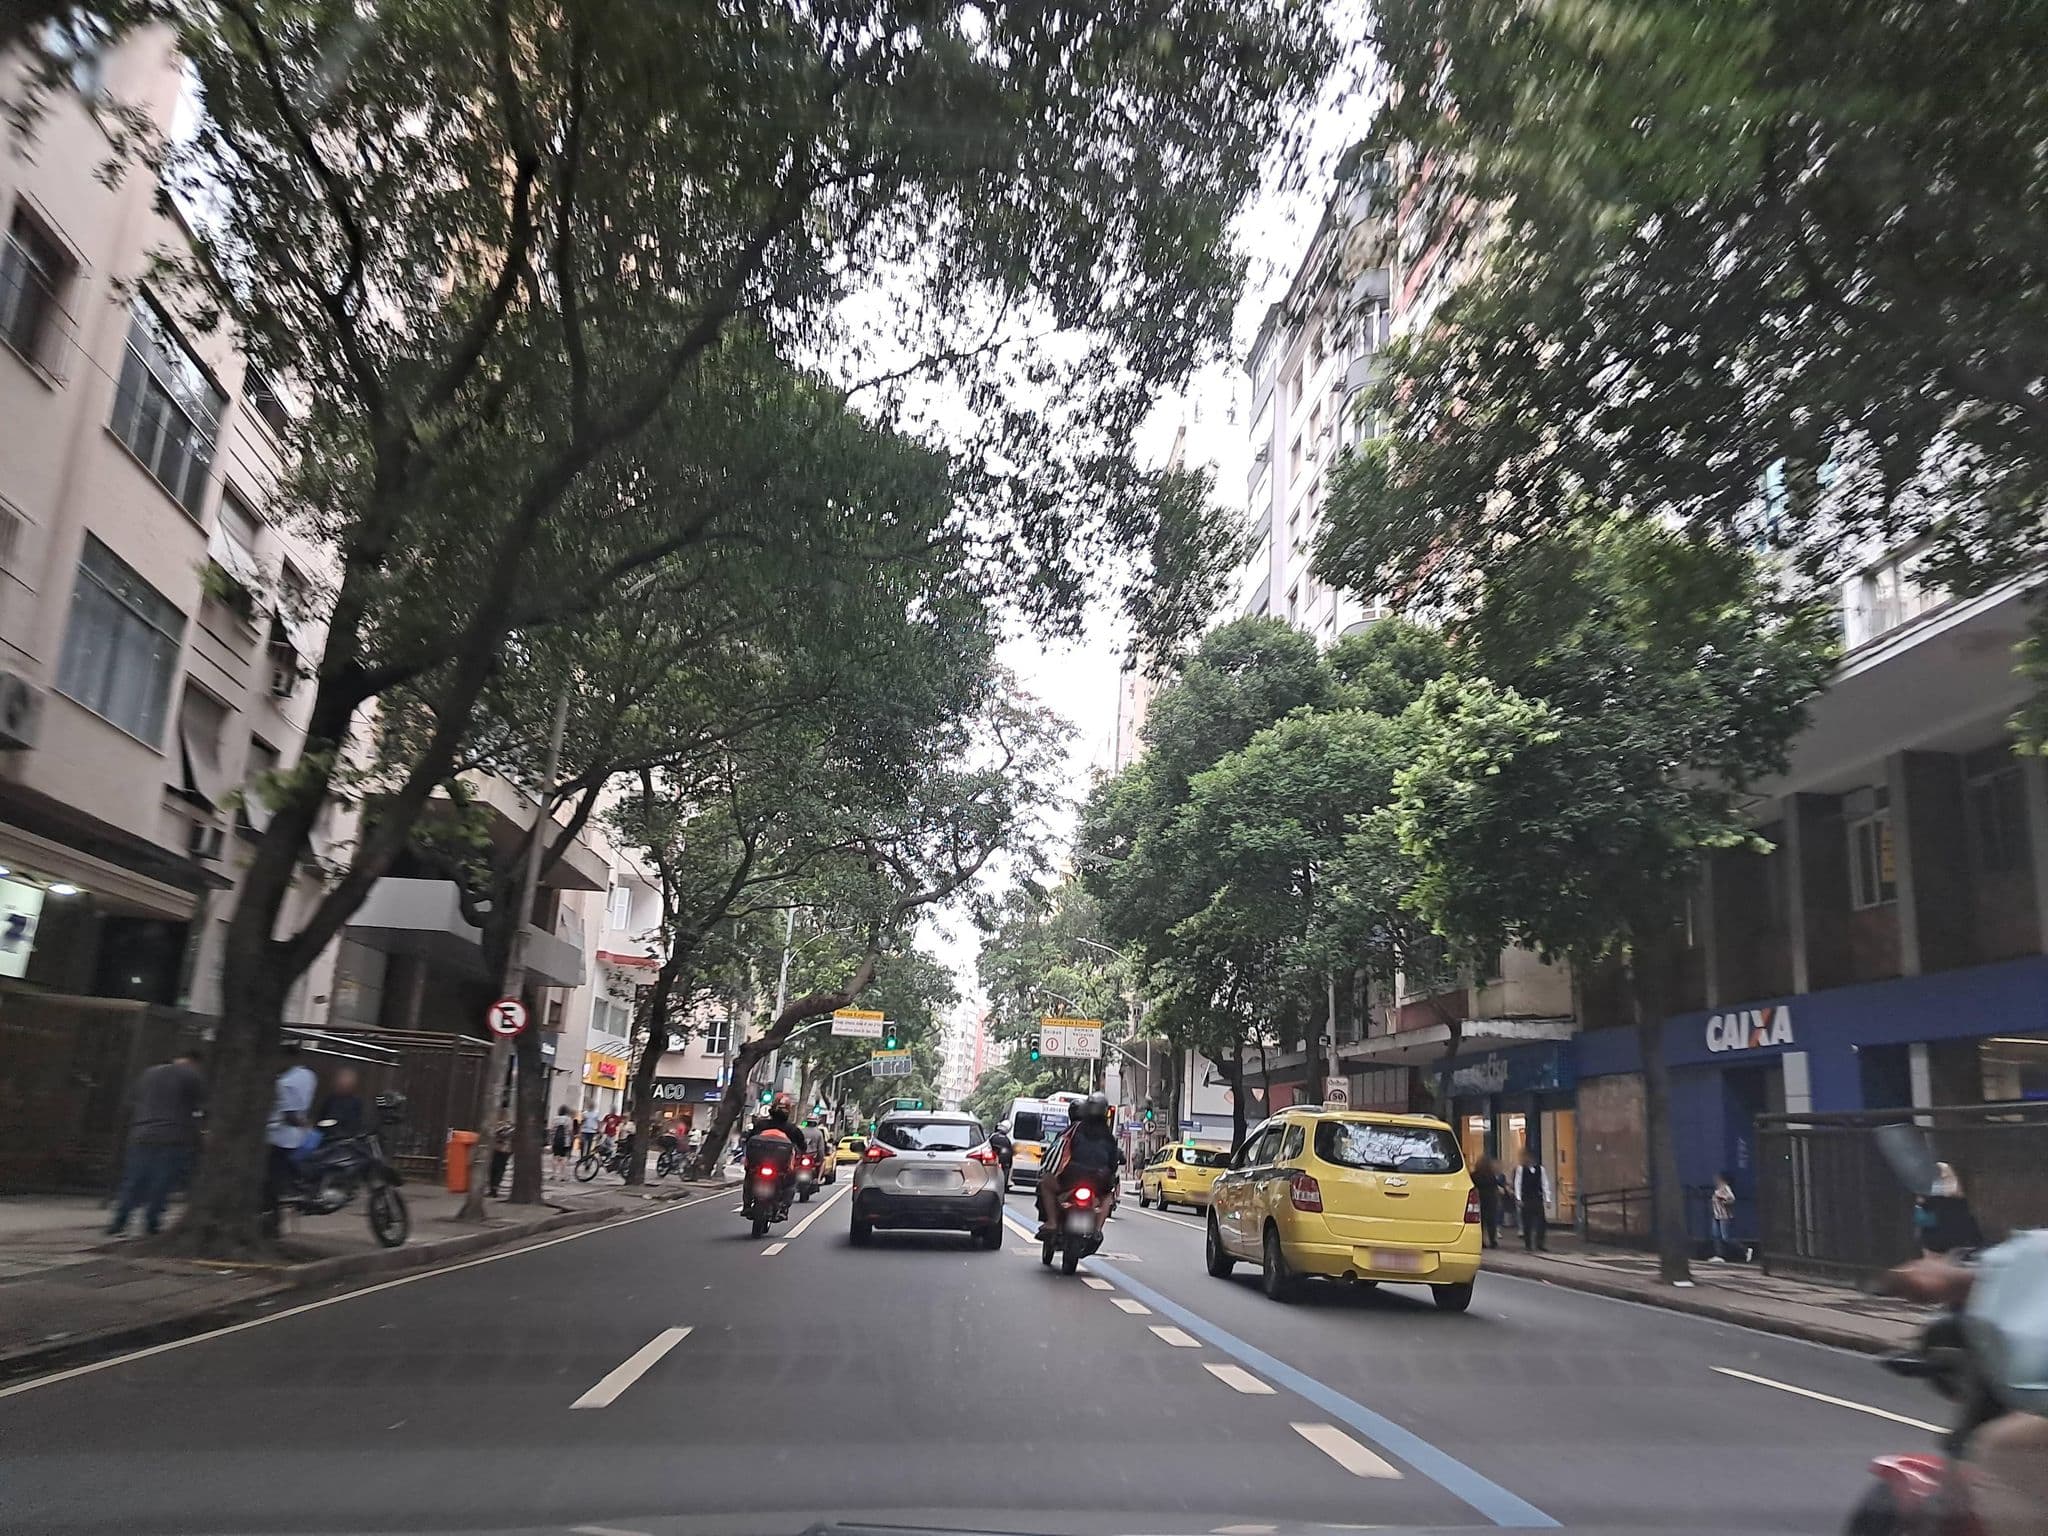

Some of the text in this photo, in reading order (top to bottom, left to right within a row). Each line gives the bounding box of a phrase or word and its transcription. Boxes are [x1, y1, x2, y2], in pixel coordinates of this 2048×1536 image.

[1706, 1005, 1795, 1053] CAIXA
[650, 1083, 686, 1100] ACO
[1332, 1093, 1344, 1101] 50
